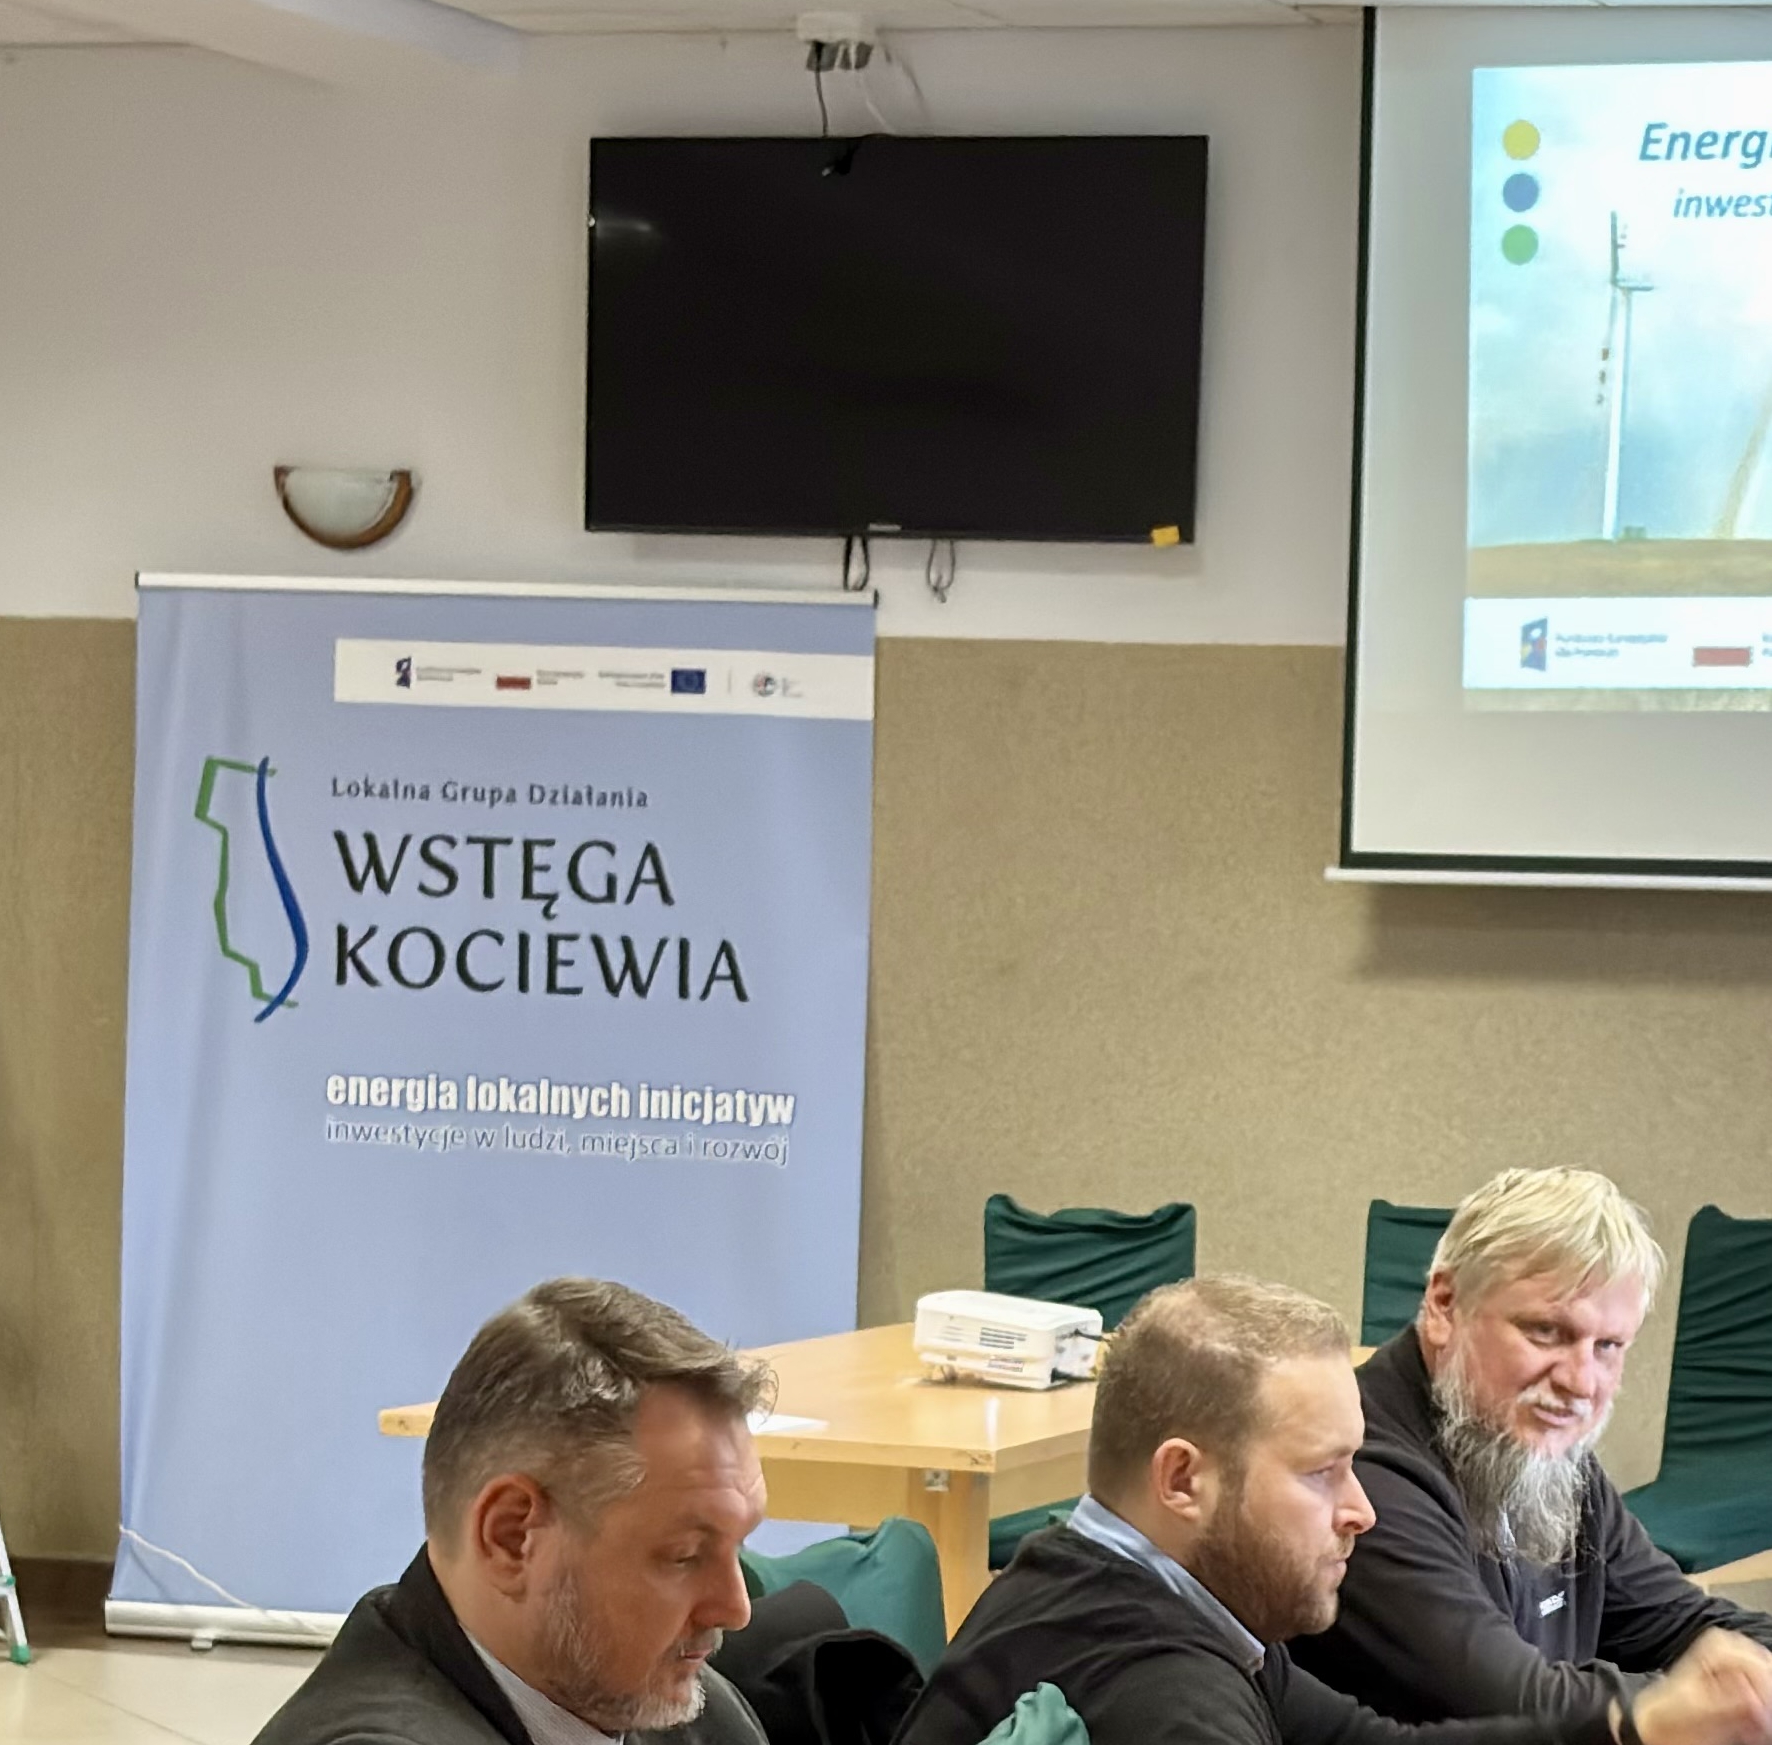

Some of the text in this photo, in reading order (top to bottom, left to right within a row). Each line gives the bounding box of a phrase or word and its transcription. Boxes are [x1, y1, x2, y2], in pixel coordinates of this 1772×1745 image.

[331, 776, 649, 810] Lokalna Grupa Działania
[333, 830, 675, 921] WSTĘGA
[334, 923, 751, 1004] KOCIEWIA
[327, 1073, 796, 1125] energia lokalnych inicjatyw
[326, 1116, 466, 1152] inwestycje
[474, 1128, 495, 1148] w
[503, 1123, 572, 1154] ludzi,
[580, 1130, 678, 1161] miejsca
[686, 1133, 695, 1155] i
